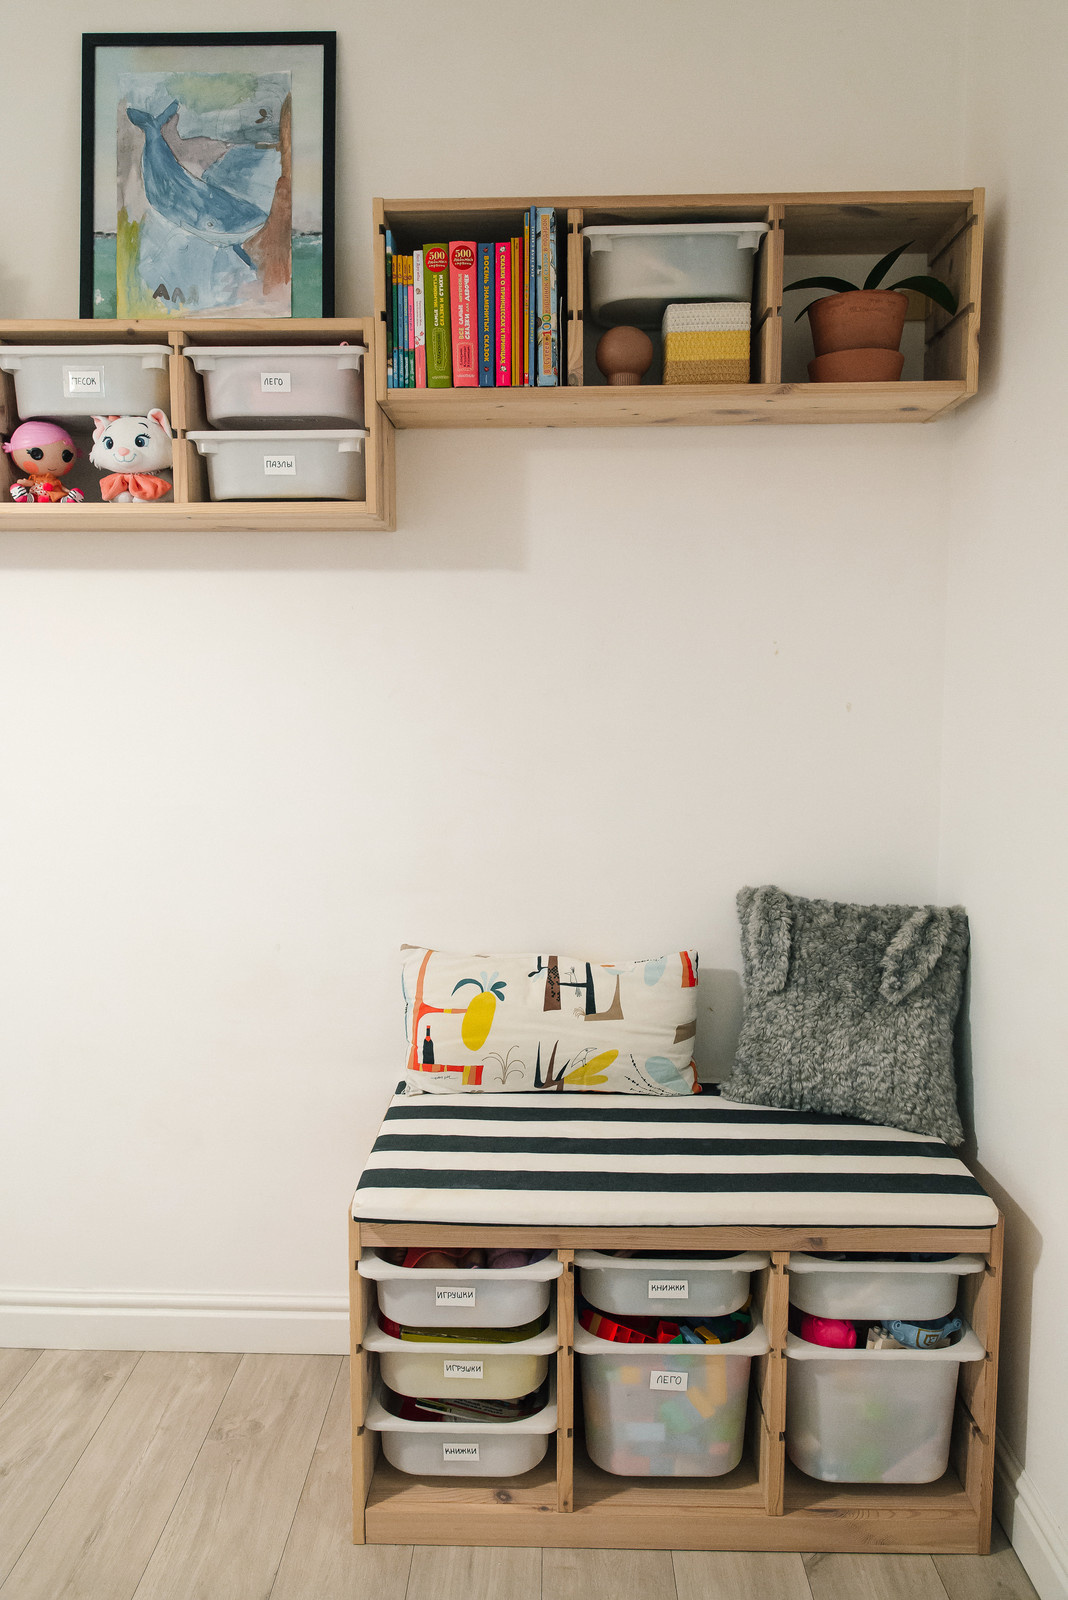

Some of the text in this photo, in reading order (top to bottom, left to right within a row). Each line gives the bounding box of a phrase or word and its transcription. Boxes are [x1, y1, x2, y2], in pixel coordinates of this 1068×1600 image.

[429, 252, 445, 260] 500
[455, 249, 472, 258] 500
[542, 314, 552, 336] 100
[71, 377, 97, 385] ПЕСОК
[264, 377, 283, 386] ЛЕГО
[266, 460, 293, 468] ПАЗЛЫ
[651, 1284, 686, 1292] КНИЖКИ
[437, 1291, 474, 1299] ИГРУШКИ
[446, 1364, 482, 1373] ИГРУШКИ
[656, 1375, 682, 1385] ЛЕГО
[444, 1446, 477, 1455] КНИЖКИ
